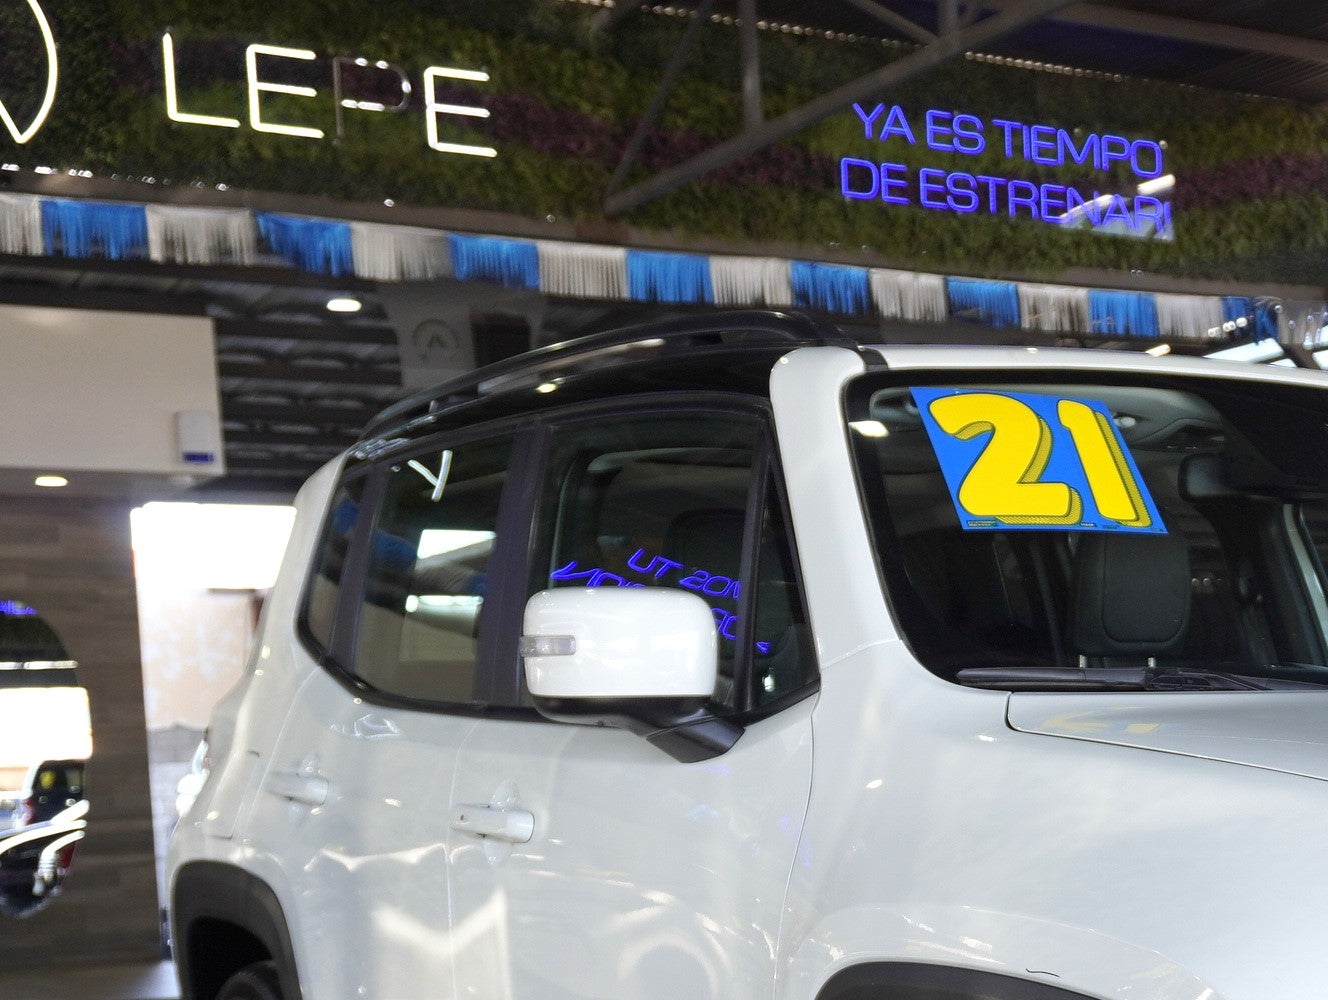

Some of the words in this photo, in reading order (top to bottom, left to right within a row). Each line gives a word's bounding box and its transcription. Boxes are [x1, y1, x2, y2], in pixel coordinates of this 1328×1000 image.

[162, 30, 498, 159] LEPE
[852, 102, 917, 145] YA
[925, 109, 986, 155] ES
[992, 119, 1164, 178] TIEMPO
[840, 157, 909, 205] DE
[928, 392, 1153, 528] 21
